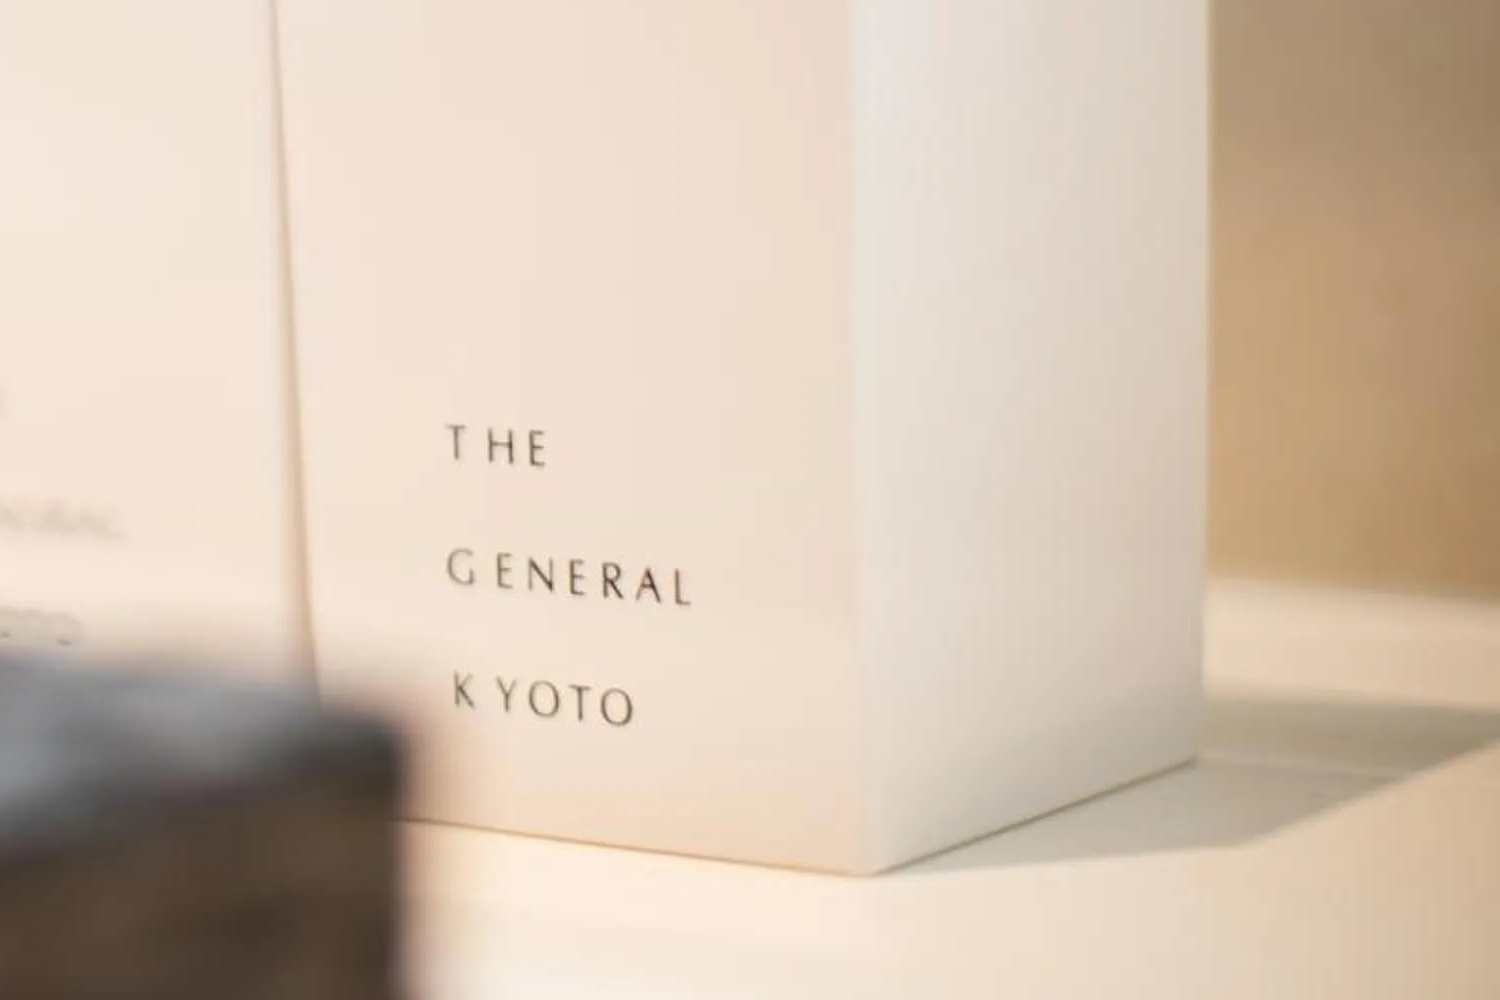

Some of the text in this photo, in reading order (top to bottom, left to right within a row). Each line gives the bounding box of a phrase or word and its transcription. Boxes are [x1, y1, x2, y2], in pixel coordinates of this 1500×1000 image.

[445, 425, 546, 468] THE
[446, 548, 692, 606] GENERAL
[453, 671, 633, 727] KYOTO
